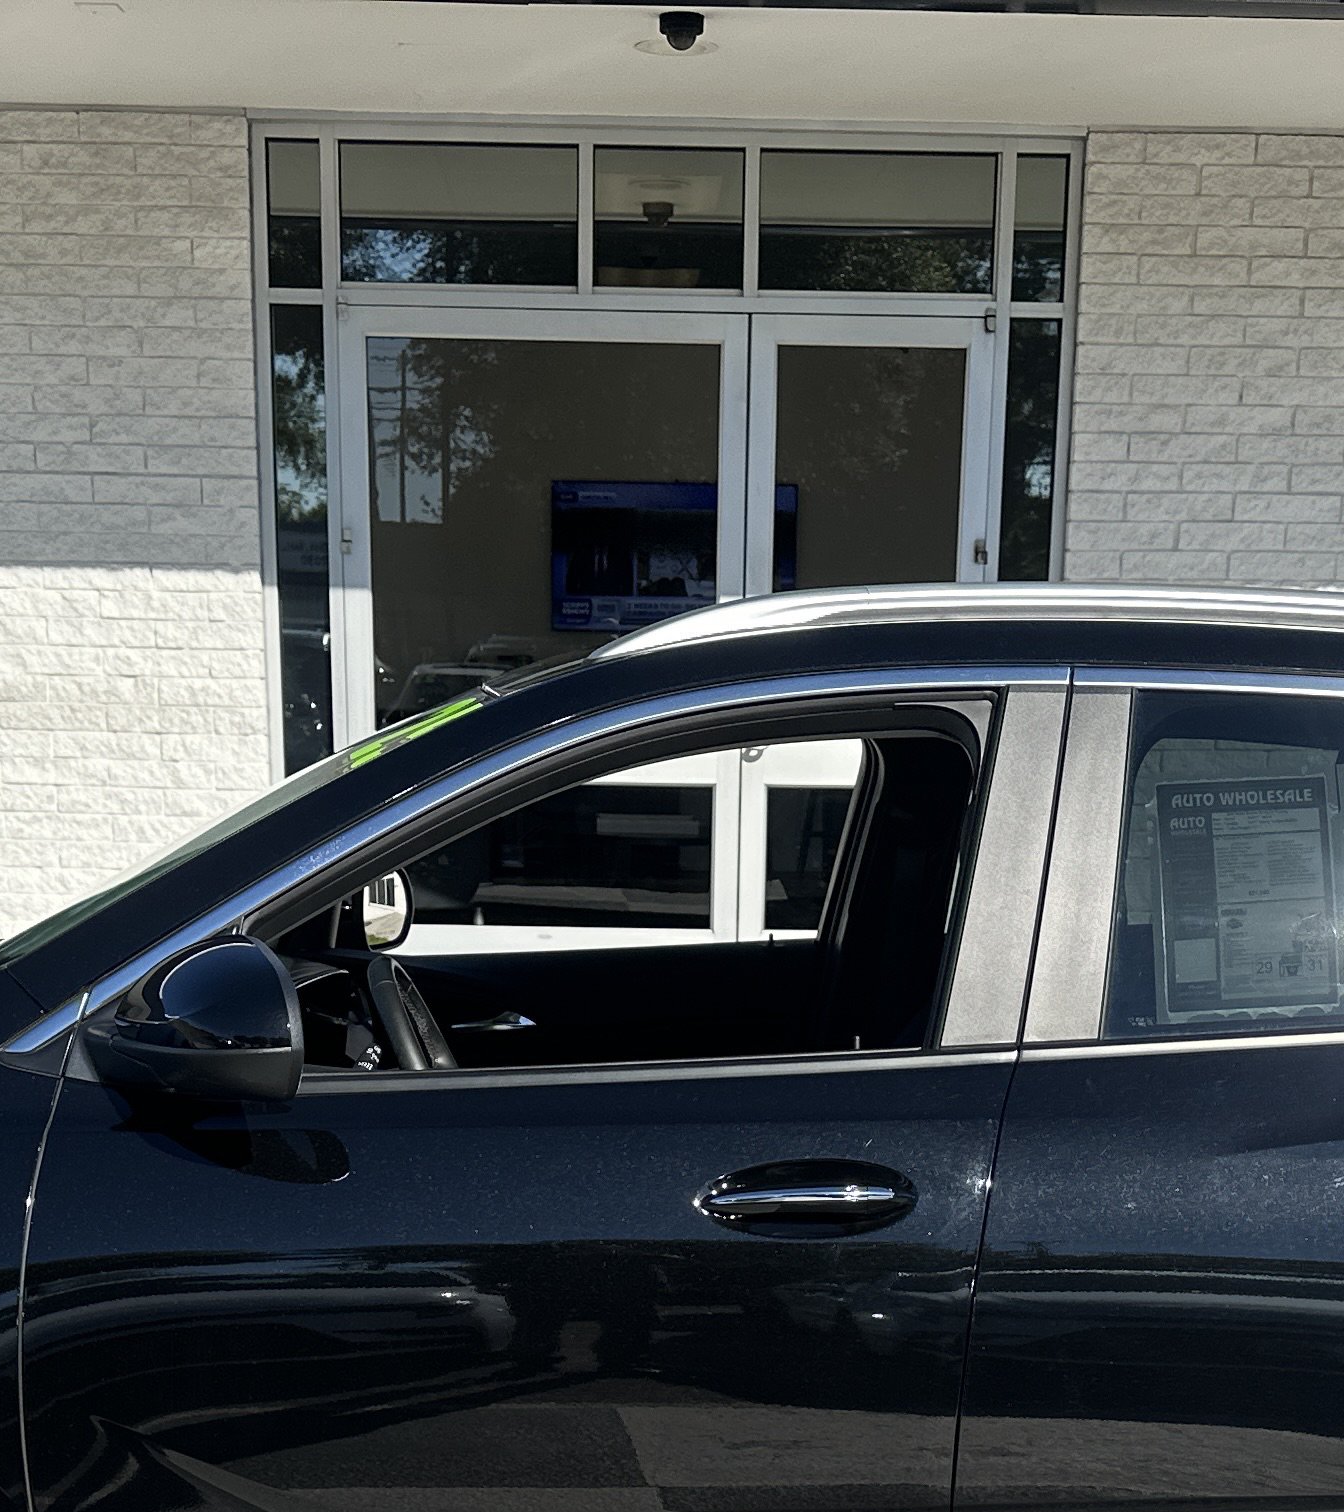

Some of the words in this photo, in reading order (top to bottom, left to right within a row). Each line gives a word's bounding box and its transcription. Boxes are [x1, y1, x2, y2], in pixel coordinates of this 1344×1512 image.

[1171, 793, 1214, 809] AUTO
[1219, 788, 1313, 806] WHOLESALE
[1169, 816, 1206, 830] AUTO
[1256, 961, 1273, 975] 29
[1308, 959, 1323, 972] 31
